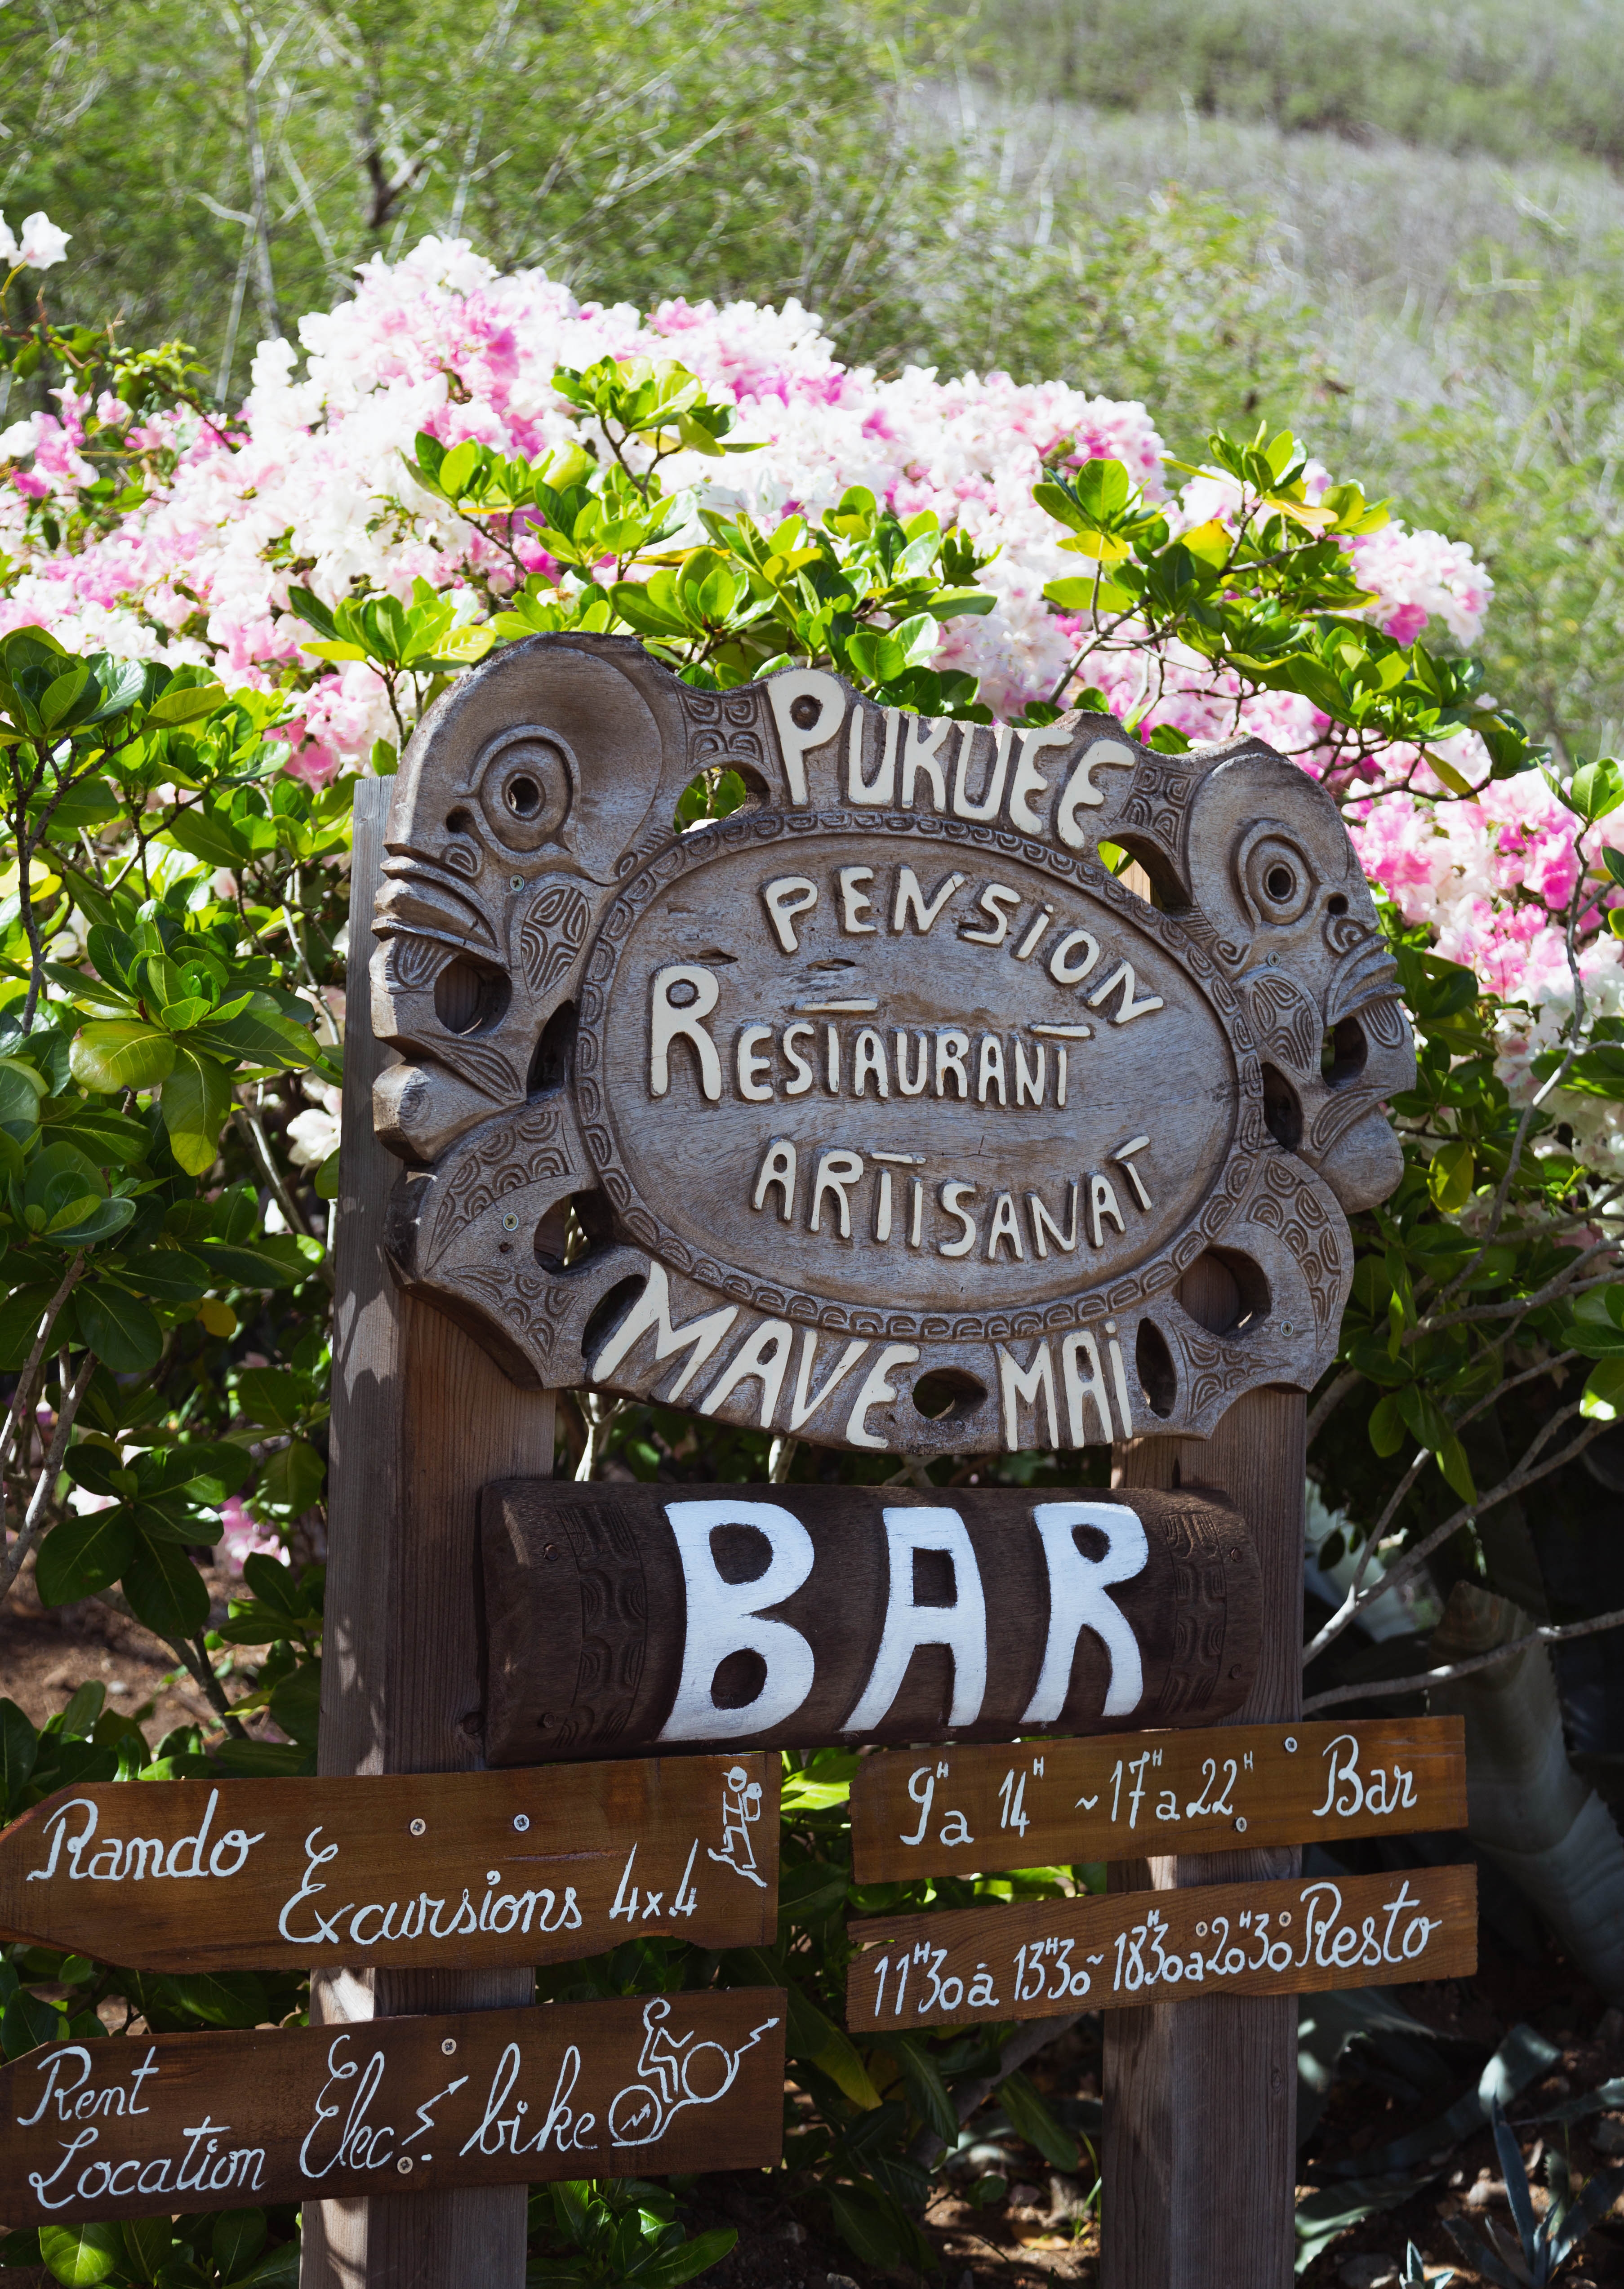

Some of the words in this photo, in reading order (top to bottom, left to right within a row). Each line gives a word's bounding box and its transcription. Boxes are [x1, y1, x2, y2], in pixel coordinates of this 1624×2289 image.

[650, 965, 1090, 1107] RESTAURANT
[752, 1135, 1152, 1258] ARTISANAT
[592, 1261, 921, 1448] MAVE
[654, 1499, 1149, 1742] BAR
[1313, 1734, 1417, 1817] Bar
[26, 1788, 267, 1881] Rando
[278, 1826, 583, 1945] Excursions
[609, 1837, 699, 1923] 4x4
[1295, 1880, 1443, 1968] Resto
[17, 2045, 159, 2126] Rent
[460, 2043, 598, 2156] bike
[29, 2115, 266, 2209] Location
